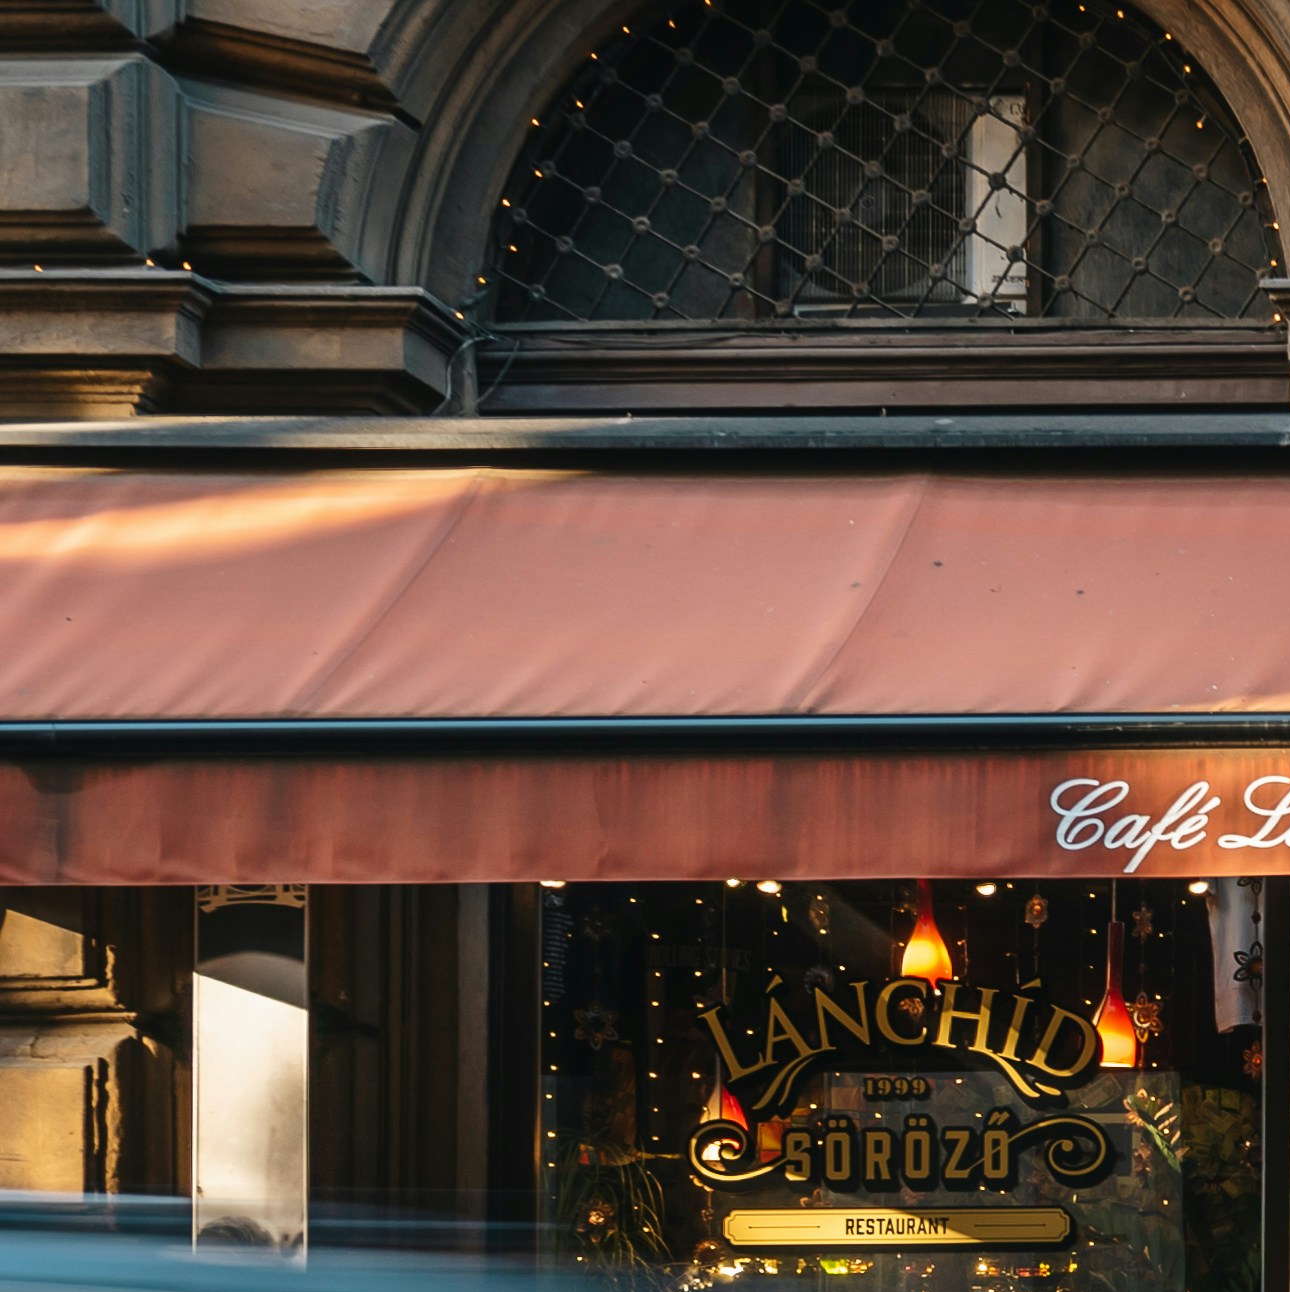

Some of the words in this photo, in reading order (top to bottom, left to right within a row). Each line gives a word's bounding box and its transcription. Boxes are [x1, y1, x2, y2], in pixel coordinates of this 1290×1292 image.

[1049, 777, 1221, 873] Café
[698, 975, 1100, 1082] LÁNCHÍD
[863, 1076, 929, 1101] 1999
[785, 1109, 1012, 1181] SÖRÖZŐ
[844, 1217, 950, 1237] RESTAURANT
